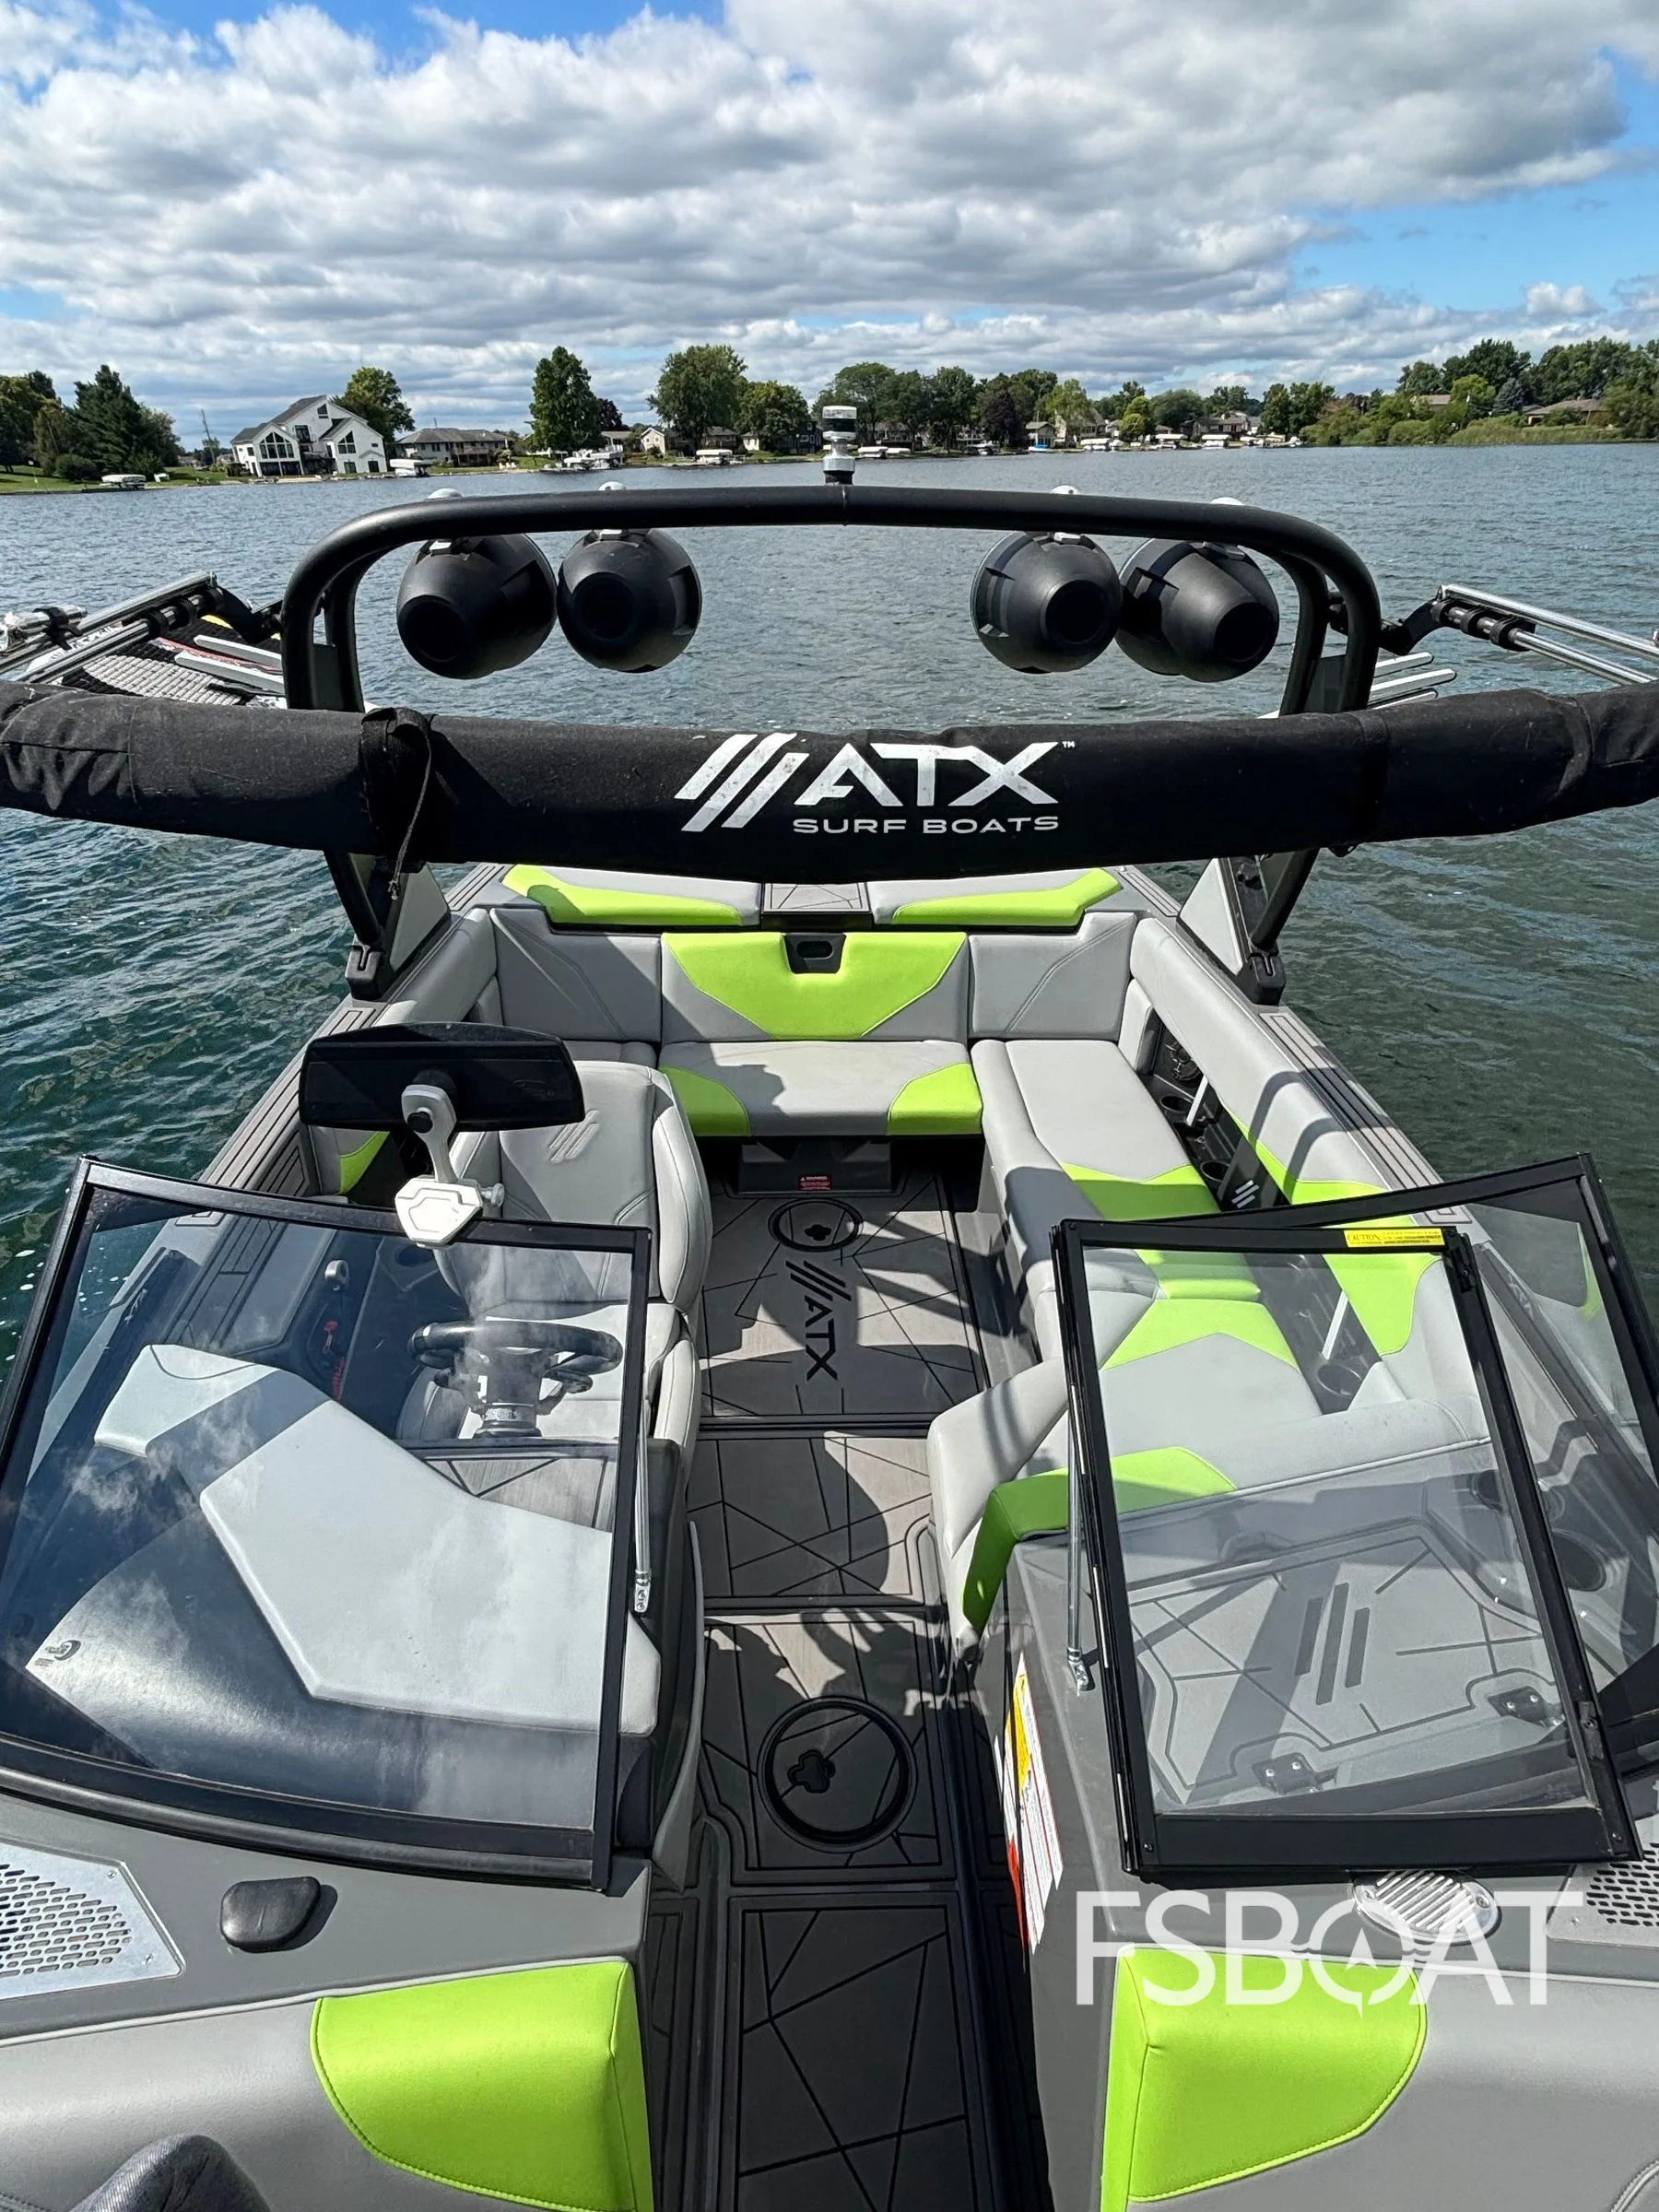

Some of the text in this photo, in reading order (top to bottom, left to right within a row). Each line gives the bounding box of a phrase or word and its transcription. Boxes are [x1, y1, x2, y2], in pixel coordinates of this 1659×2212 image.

[794, 742, 1059, 806] ATX
[793, 817, 1059, 834] SURF BOATS
[804, 1294, 838, 1382] ATX
